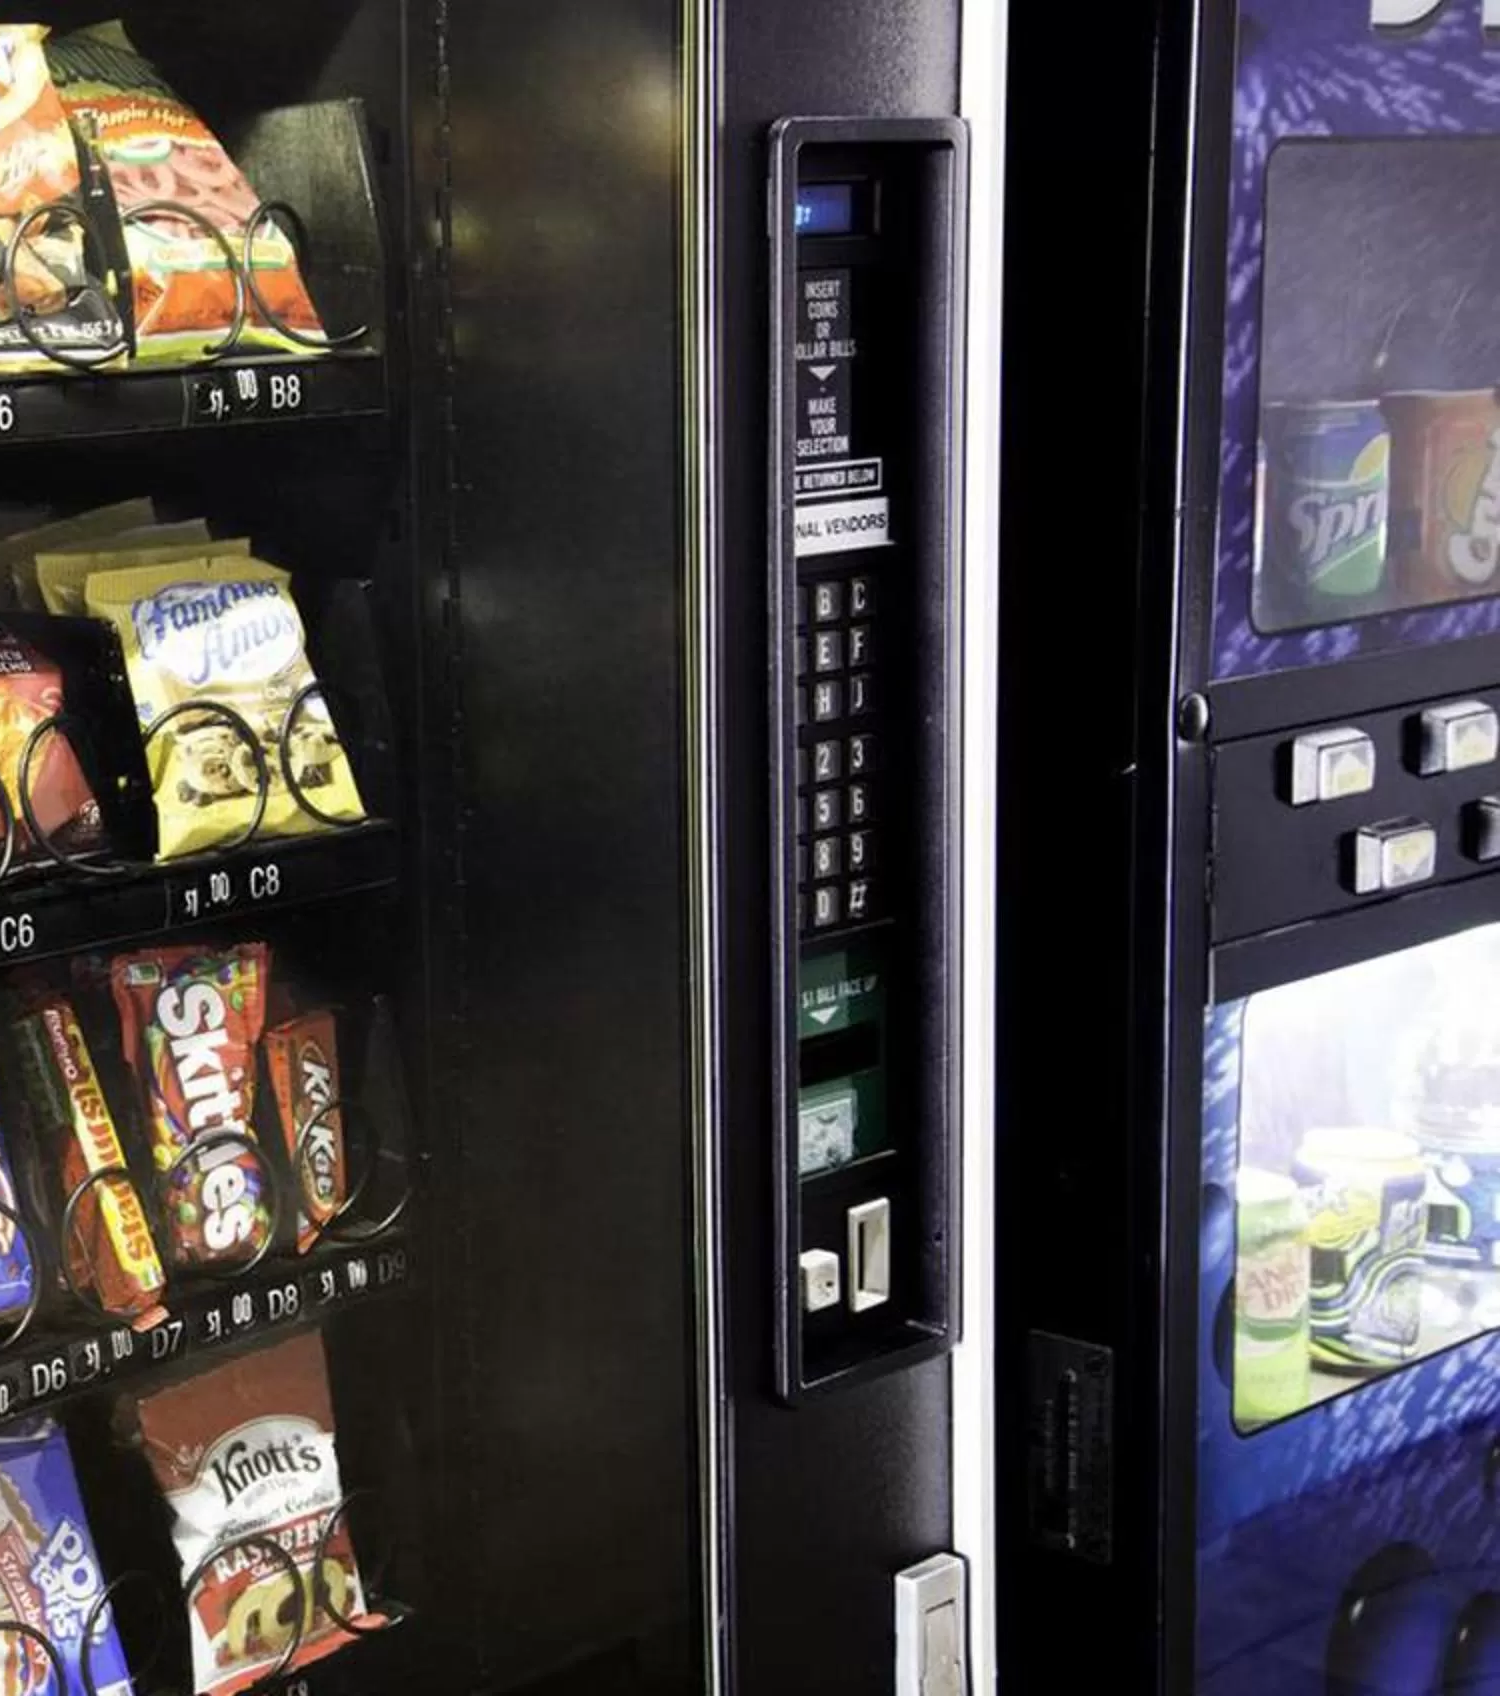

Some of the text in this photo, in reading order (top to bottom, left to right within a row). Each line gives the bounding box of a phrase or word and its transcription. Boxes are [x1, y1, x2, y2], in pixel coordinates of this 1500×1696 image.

[804, 279, 841, 299] INSERT
[795, 340, 827, 361] OLLAR
[270, 375, 301, 409] B8
[808, 396, 837, 415] MAKE
[809, 417, 837, 436] YOUR
[797, 435, 850, 458] SELECTION
[825, 512, 886, 535] VENDORS
[818, 581, 866, 616] B C
[189, 605, 295, 686] Amos
[818, 631, 864, 665] E F
[818, 680, 864, 714] H J
[817, 739, 864, 775] 2 3
[817, 786, 865, 823] 5 6
[818, 833, 864, 872] 8 9
[250, 863, 281, 900] C8
[0, 912, 36, 952] C6
[157, 983, 255, 1251] Skittles
[269, 1284, 298, 1320] D8
[152, 1321, 183, 1360] D7
[31, 1358, 67, 1396] D6
[211, 1433, 322, 1506] Knott's
